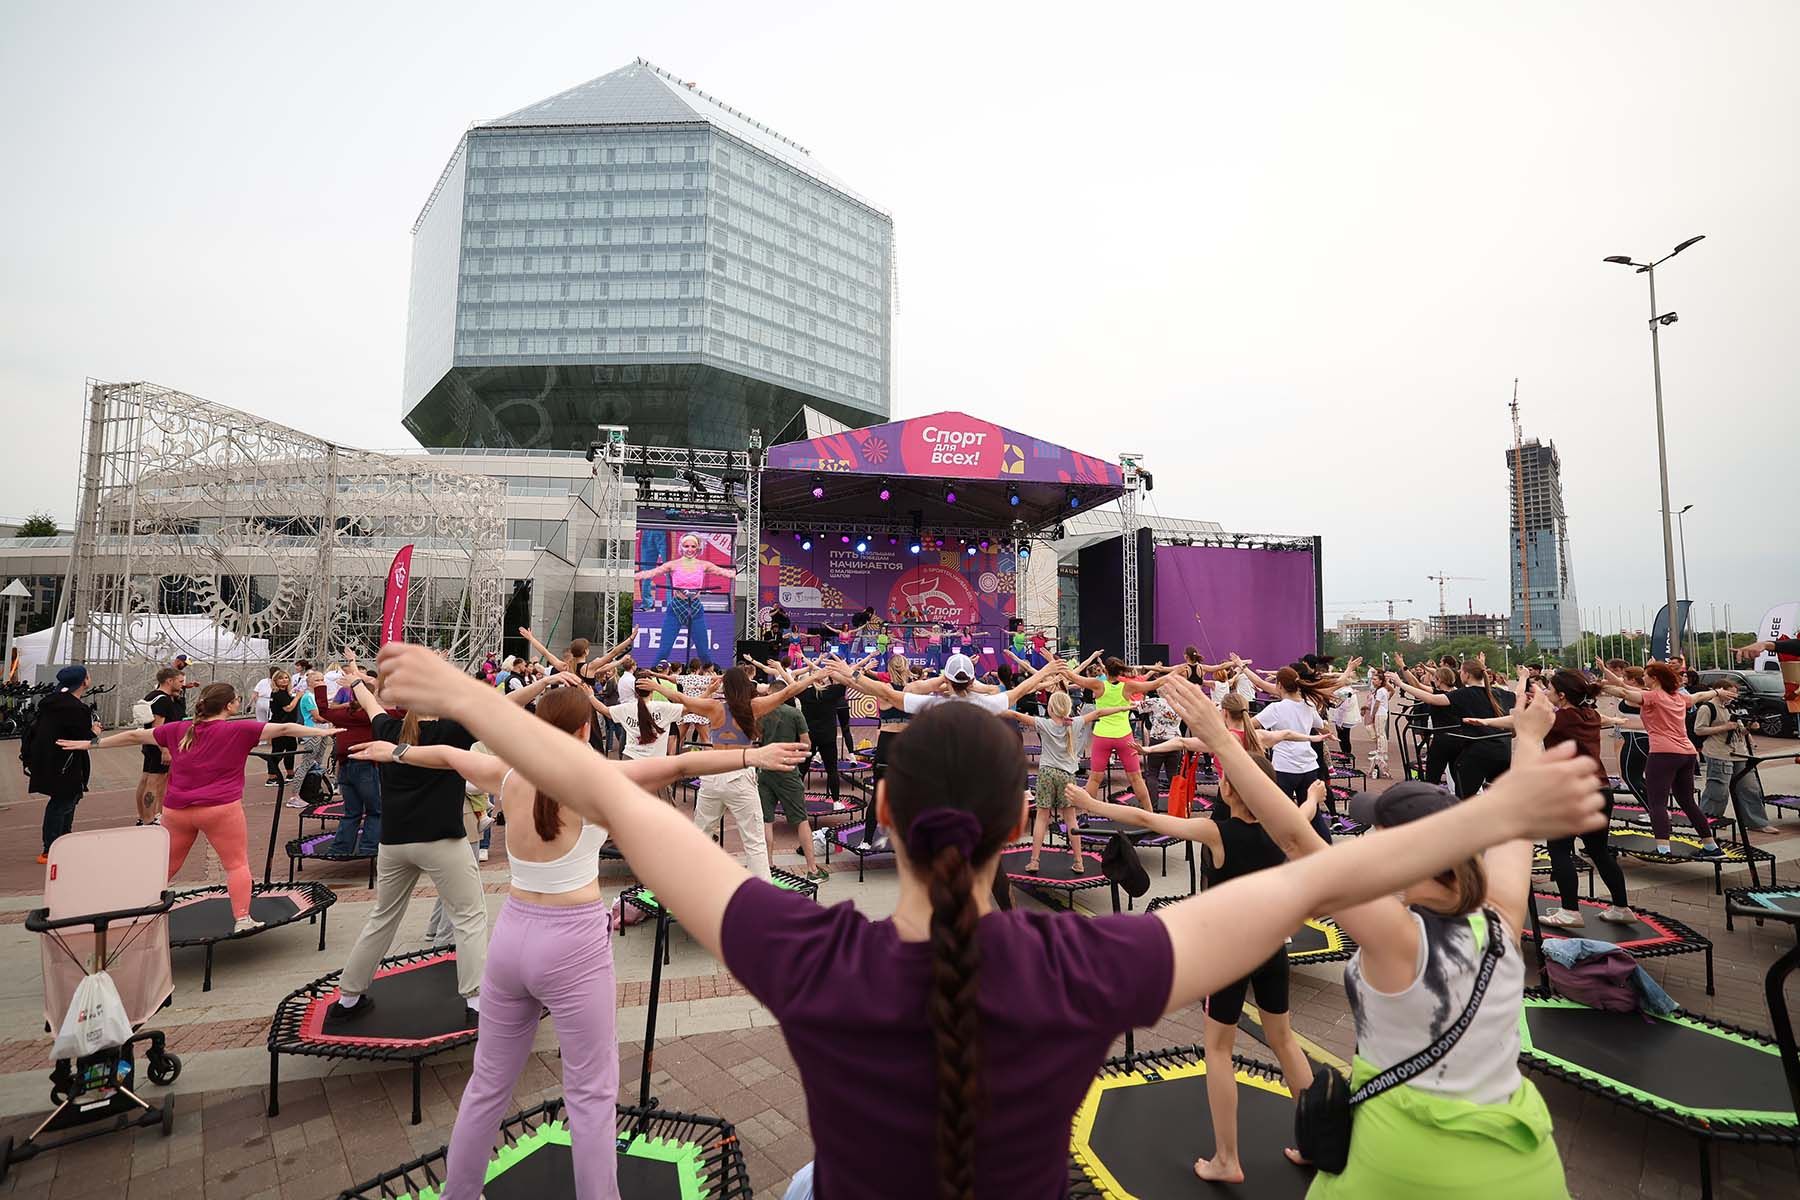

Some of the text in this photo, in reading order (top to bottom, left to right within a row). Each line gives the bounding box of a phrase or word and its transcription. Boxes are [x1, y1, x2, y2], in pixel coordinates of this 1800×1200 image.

[922, 426, 987, 448] Спорт
[933, 443, 957, 452] для
[931, 451, 980, 466] всех!
[829, 550, 859, 559] ПУТЬ
[829, 560, 904, 571] НАЧИНАЕТСЯ
[926, 605, 964, 617] Спорт
[1767, 617, 1782, 657] BGEE
[1478, 952, 1496, 991] HUGO
[1460, 991, 1483, 1026] HUGO
[1430, 1023, 1463, 1058] HUGO
[1396, 1052, 1434, 1080] HUGO
[1366, 1070, 1399, 1094] HUGO
